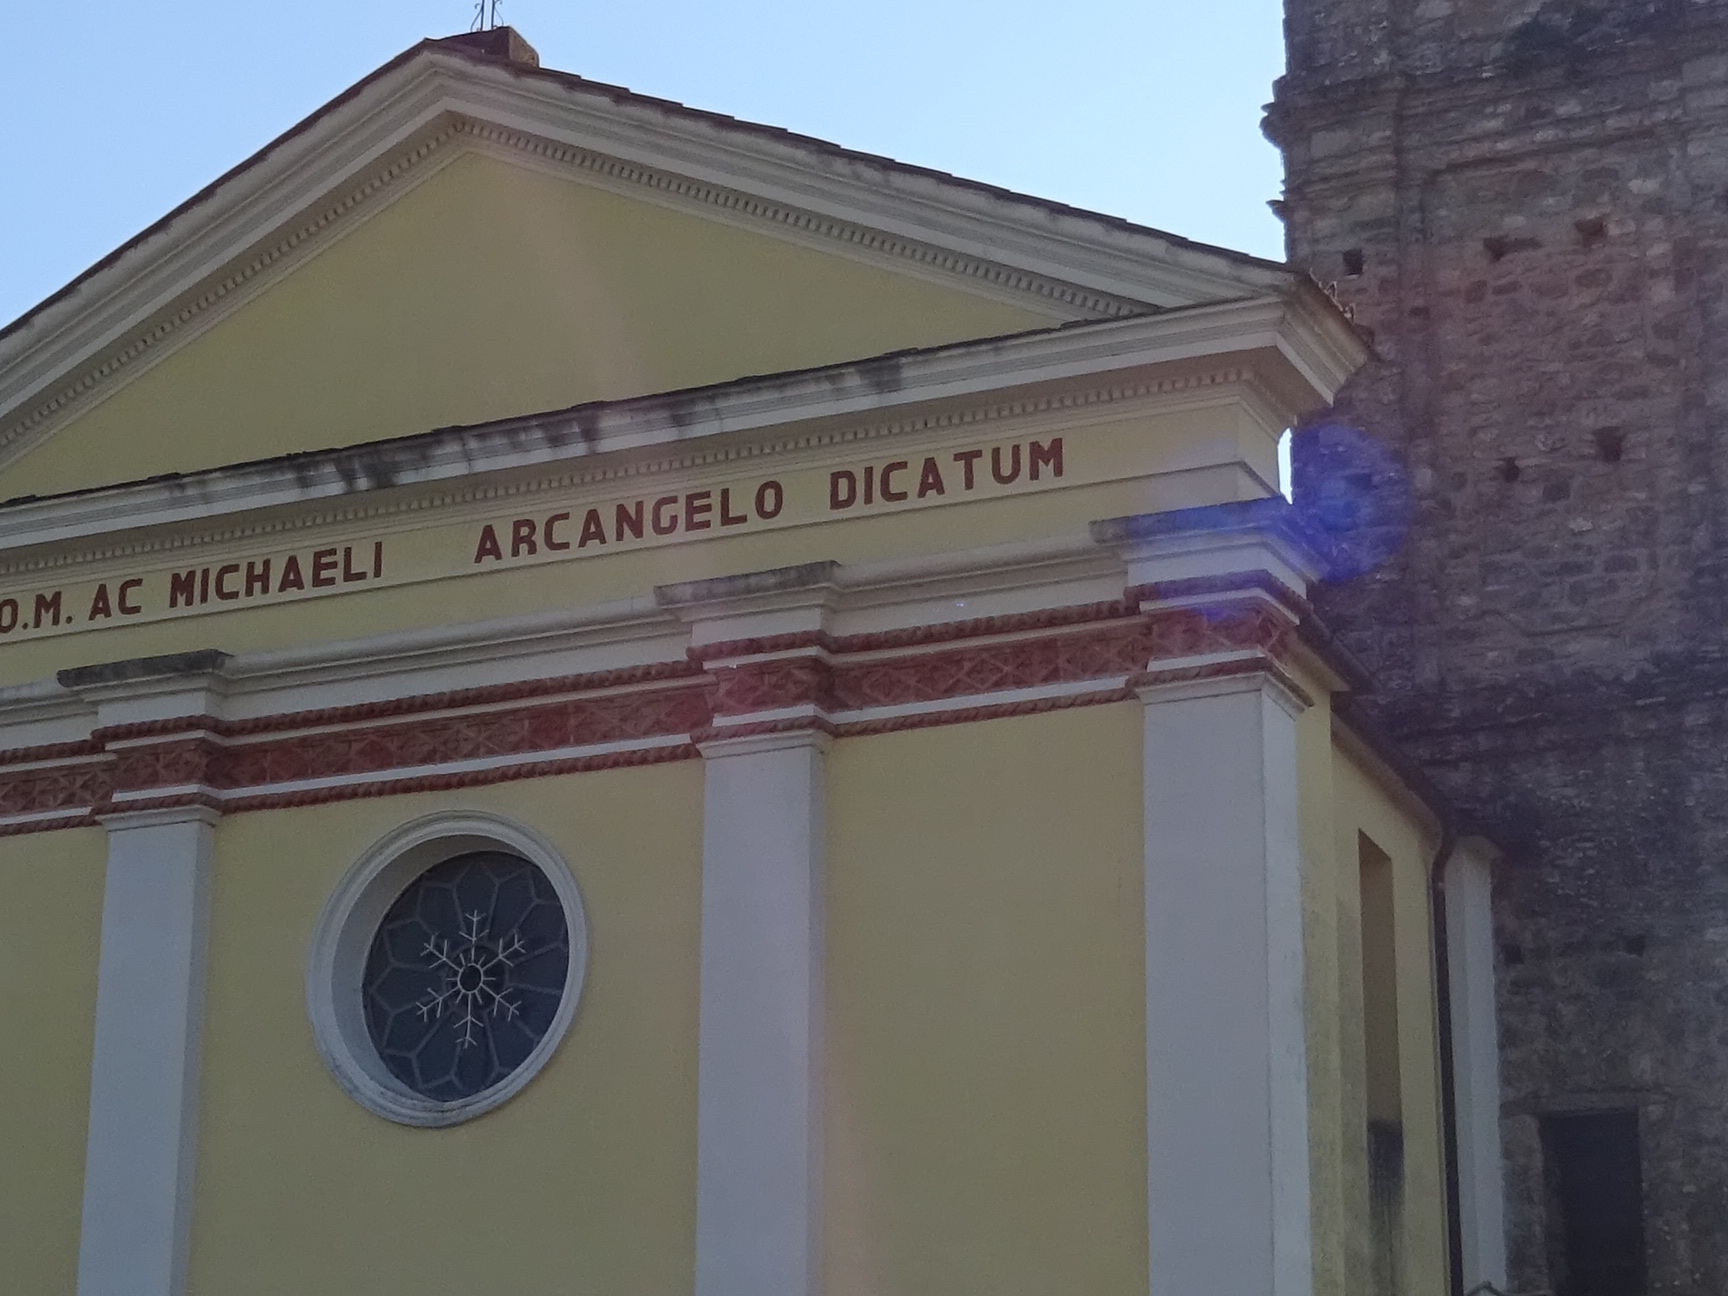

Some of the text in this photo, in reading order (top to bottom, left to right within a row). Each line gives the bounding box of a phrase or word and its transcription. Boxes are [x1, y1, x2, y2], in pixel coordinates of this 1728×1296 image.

[88, 577, 144, 621] AC
[169, 541, 383, 608] MICHAELI
[473, 480, 784, 564] ARCANGELO
[828, 437, 1064, 511] DICATUM
